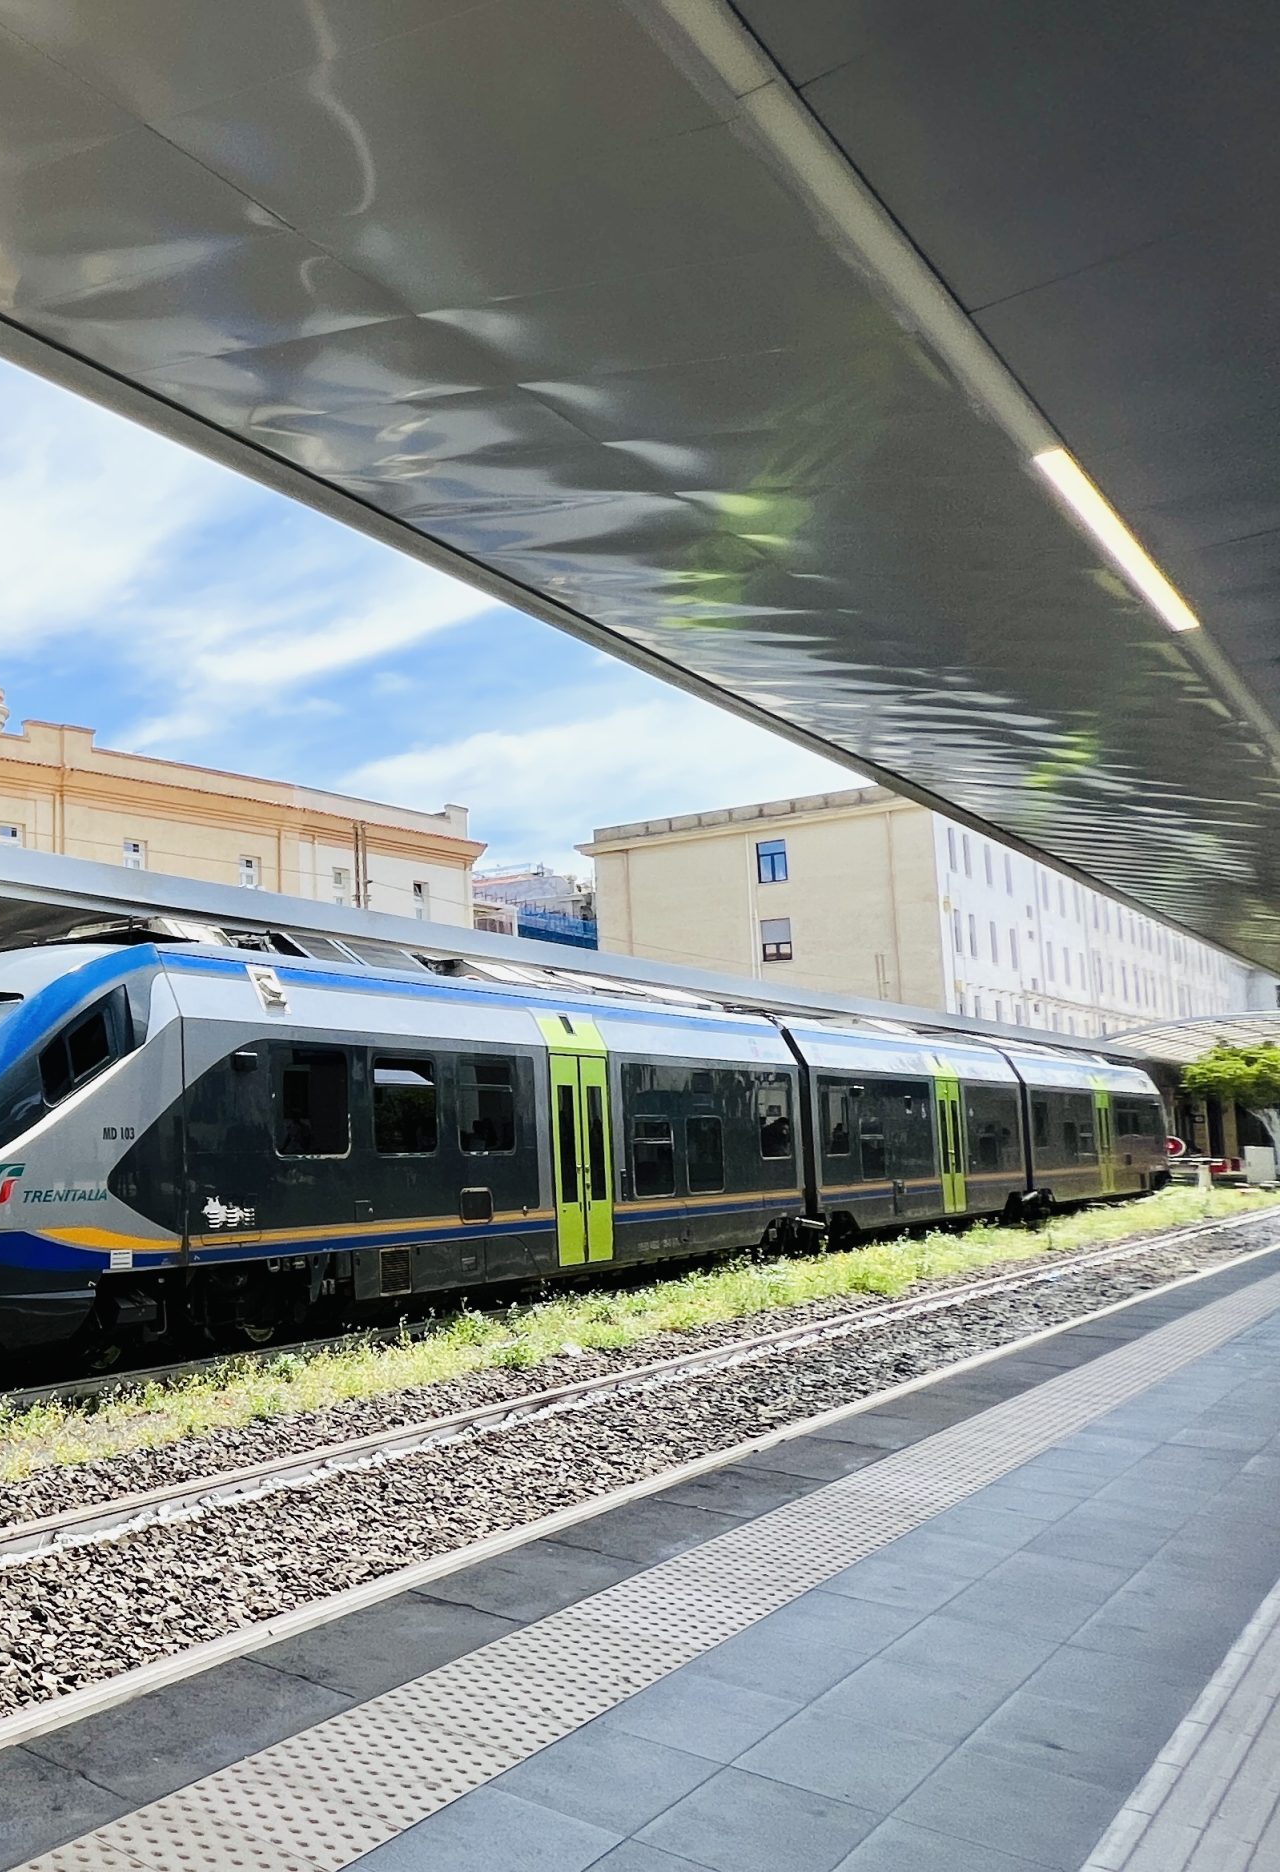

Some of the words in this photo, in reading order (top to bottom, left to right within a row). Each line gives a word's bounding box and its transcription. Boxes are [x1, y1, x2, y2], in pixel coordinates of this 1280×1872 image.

[102, 1127, 117, 1140] MD
[120, 1127, 135, 1140] 103
[23, 1188, 108, 1204] TRENITALIA
